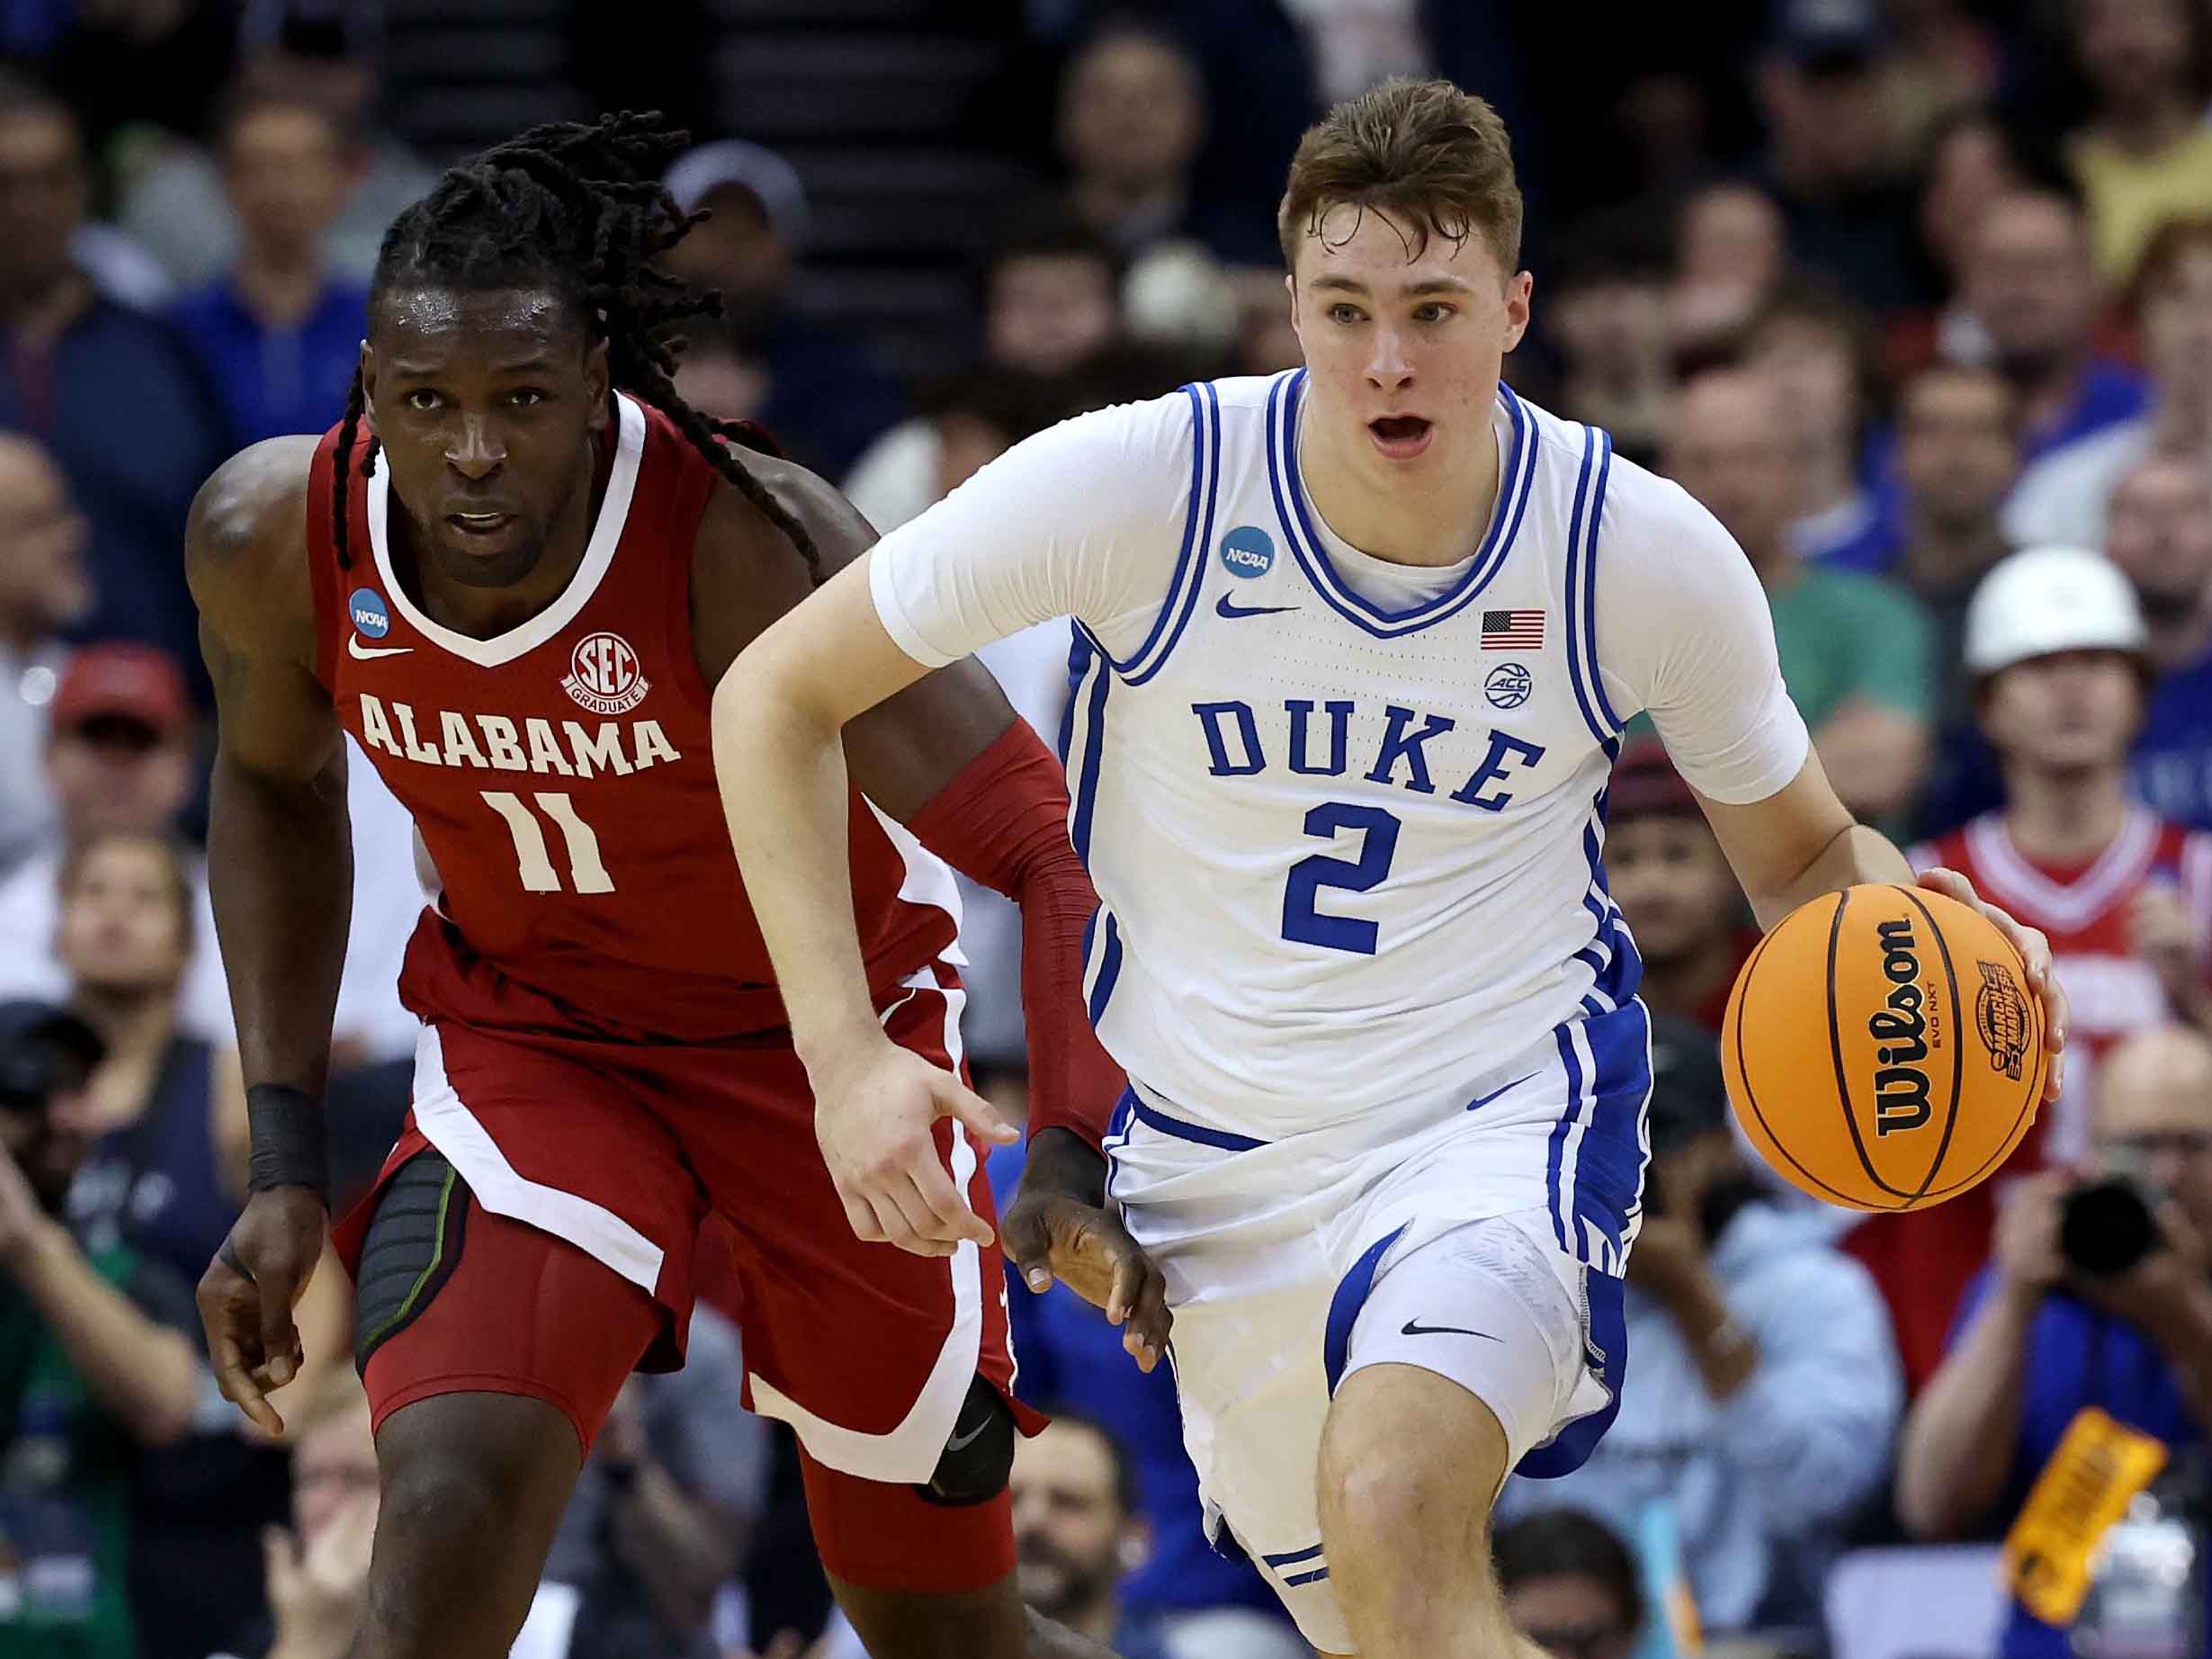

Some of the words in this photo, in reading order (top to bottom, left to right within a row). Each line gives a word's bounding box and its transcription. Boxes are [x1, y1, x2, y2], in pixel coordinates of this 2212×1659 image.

[1226, 546, 1268, 569] NCAA
[355, 609, 389, 629] NCAA
[578, 637, 632, 694] SEC
[1489, 678, 1529, 691] ACC
[571, 687, 640, 713] GRADUATE
[360, 693, 682, 779] ALABAMA
[1191, 700, 1546, 812] DUKE
[479, 791, 615, 893] 11
[1281, 801, 1402, 955] 2
[1927, 981, 1939, 1011] NXT
[1990, 991, 2006, 1052] MARCH
[1998, 965, 2019, 1046] MADNESS
[1868, 919, 1932, 1137] Wilson
[1930, 1016, 1941, 1049] EVO
